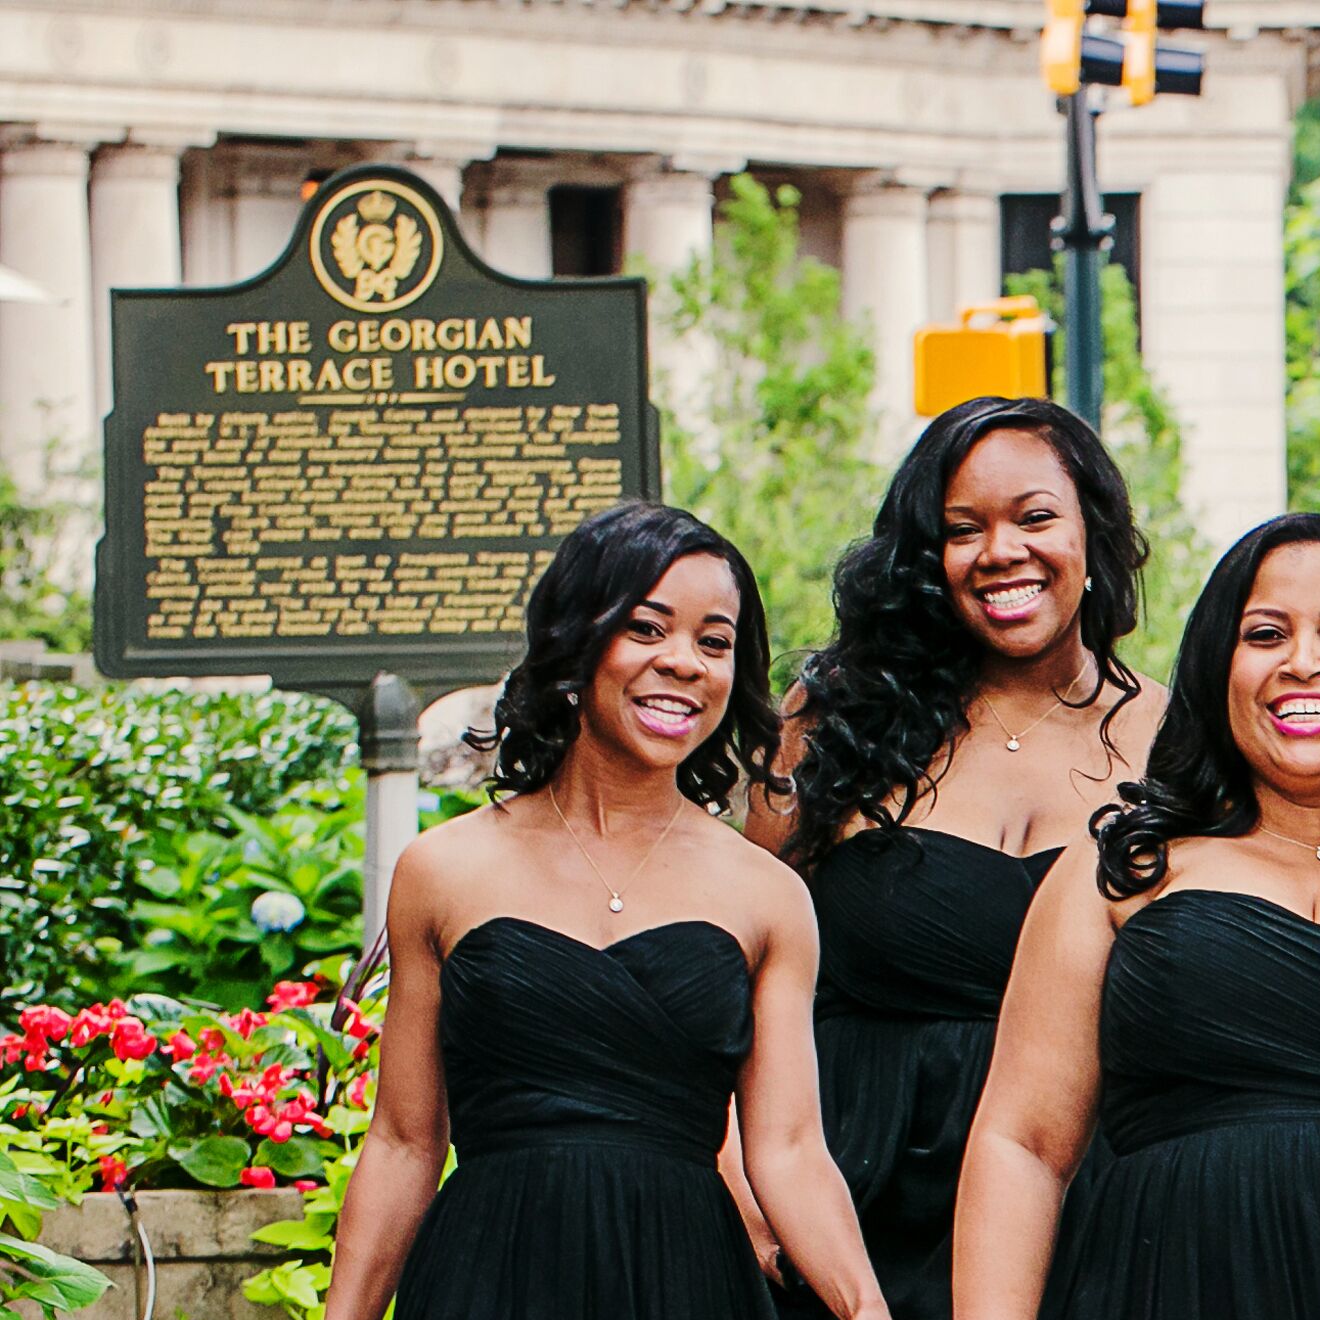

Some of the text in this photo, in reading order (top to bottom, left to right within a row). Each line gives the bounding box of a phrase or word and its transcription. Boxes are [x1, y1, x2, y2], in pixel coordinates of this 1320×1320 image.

[226, 316, 533, 355] THE GEORGIAN
[205, 354, 556, 393] TERRACE HOTEL
